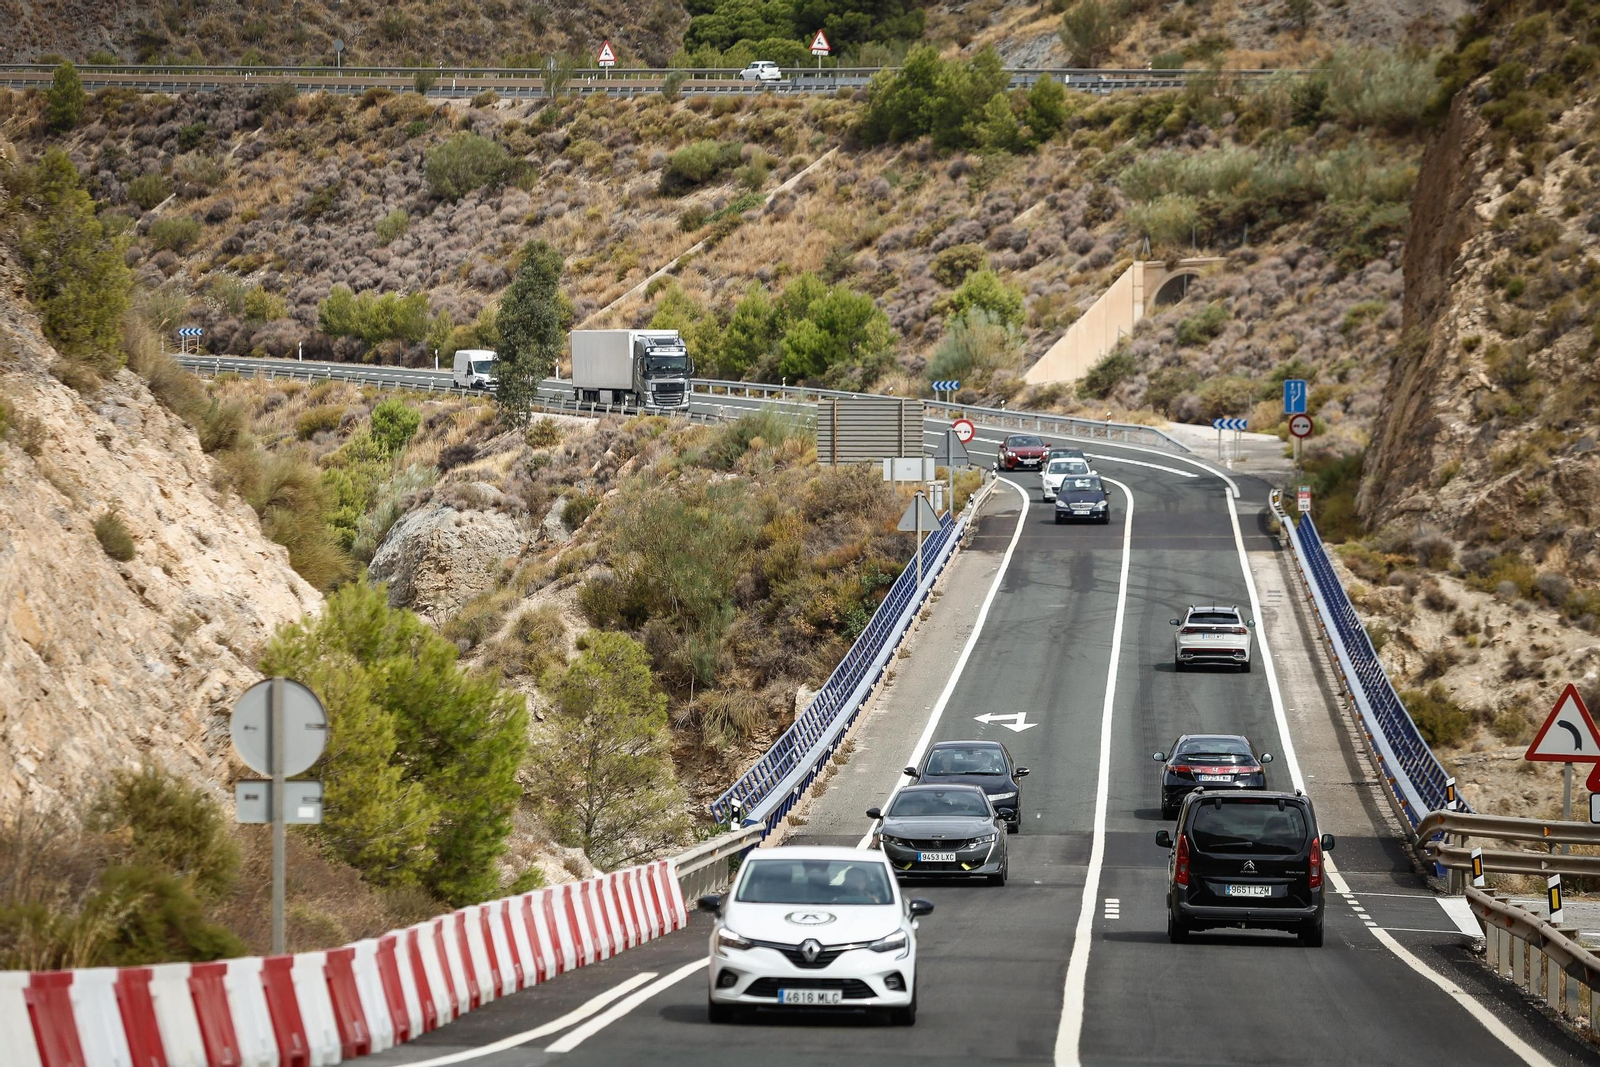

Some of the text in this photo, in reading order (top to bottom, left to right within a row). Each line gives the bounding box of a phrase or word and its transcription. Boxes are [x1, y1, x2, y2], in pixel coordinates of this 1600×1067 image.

[922, 853, 954, 861] 9453 LXC
[1231, 885, 1270, 895] 9651 LZM
[786, 992, 839, 1005] 4616 MLC
